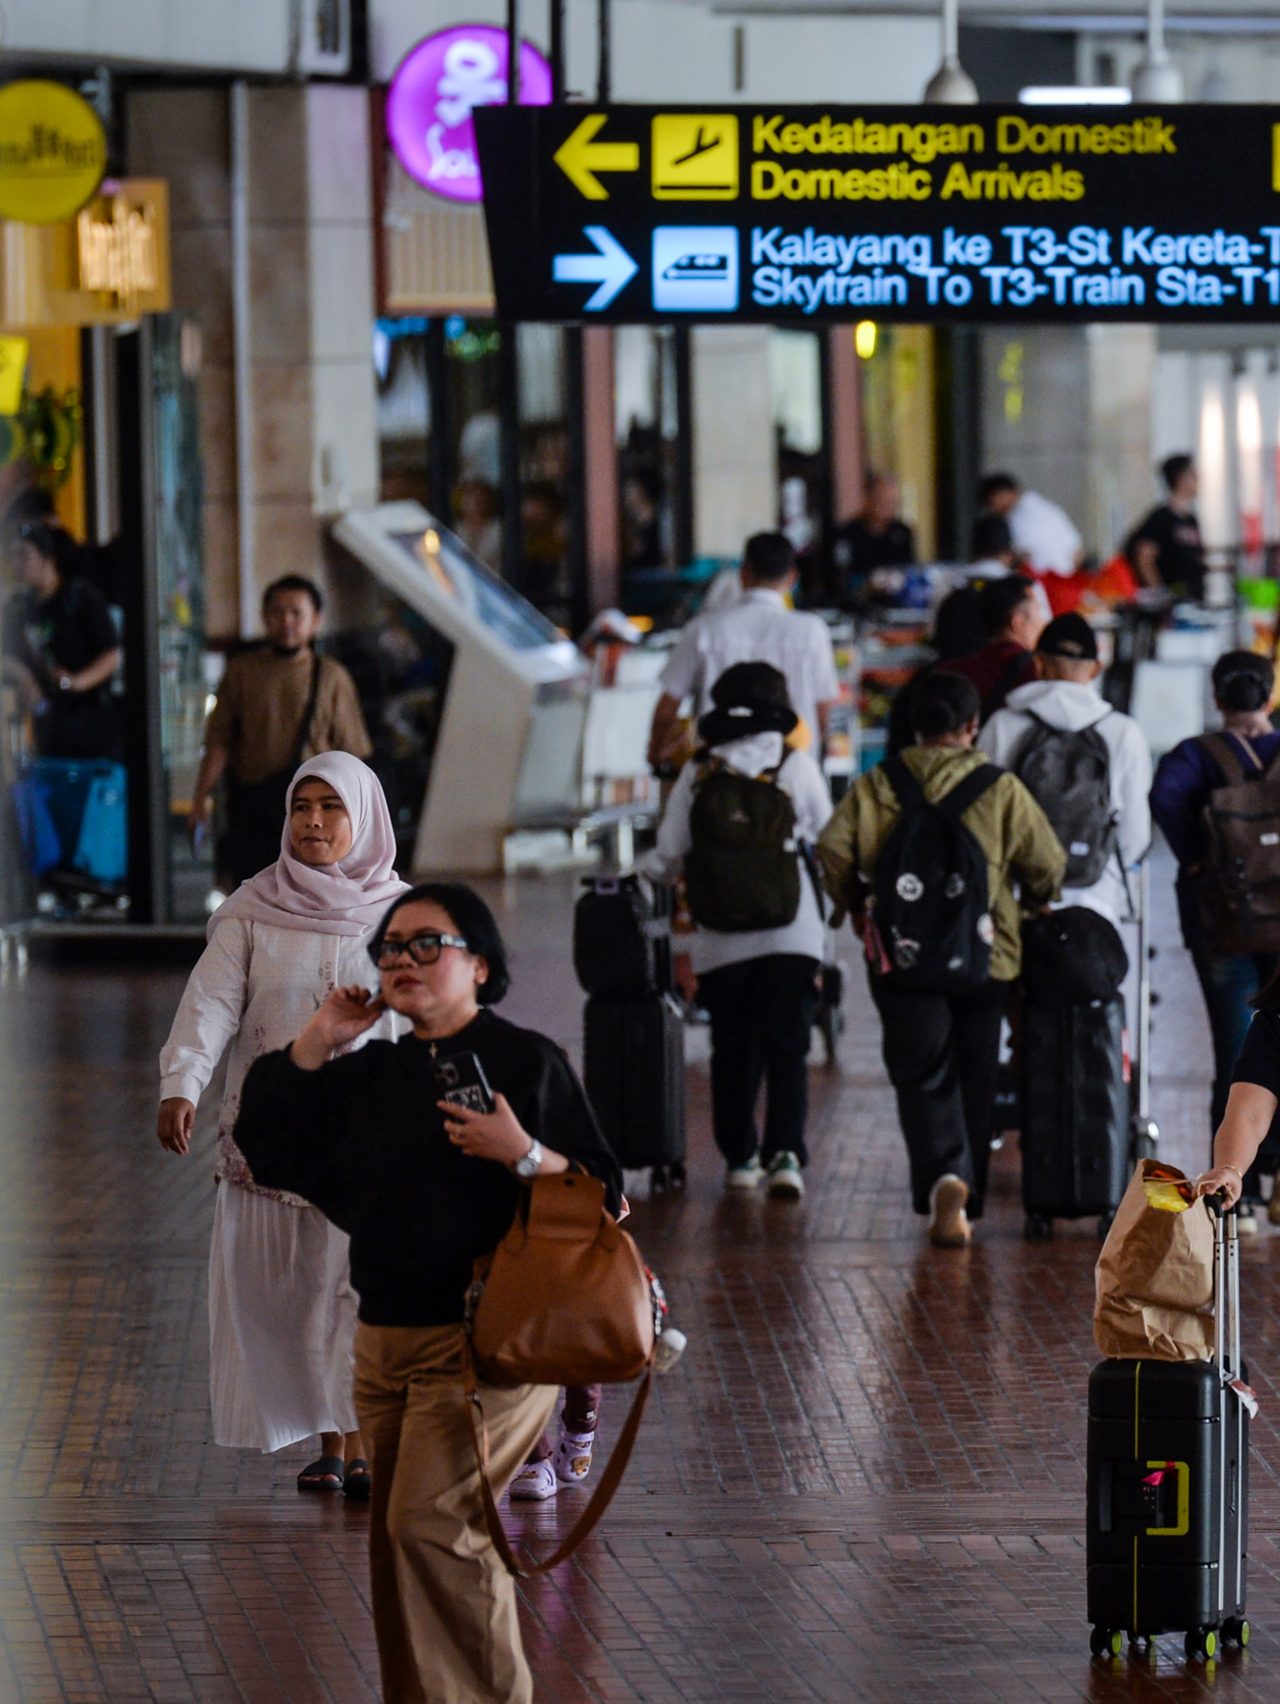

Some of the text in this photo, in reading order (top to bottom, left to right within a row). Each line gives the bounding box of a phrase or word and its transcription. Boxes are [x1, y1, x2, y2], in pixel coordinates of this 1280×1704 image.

[752, 115, 1177, 163] Kedatangan Domestik
[751, 160, 1085, 200] Domestic Arrivals
[751, 226, 932, 276] Kalayang
[943, 226, 992, 265] ke
[1001, 226, 1111, 265] T3-St
[752, 266, 1280, 315] Skytrain To T3-Train Sta-T1
